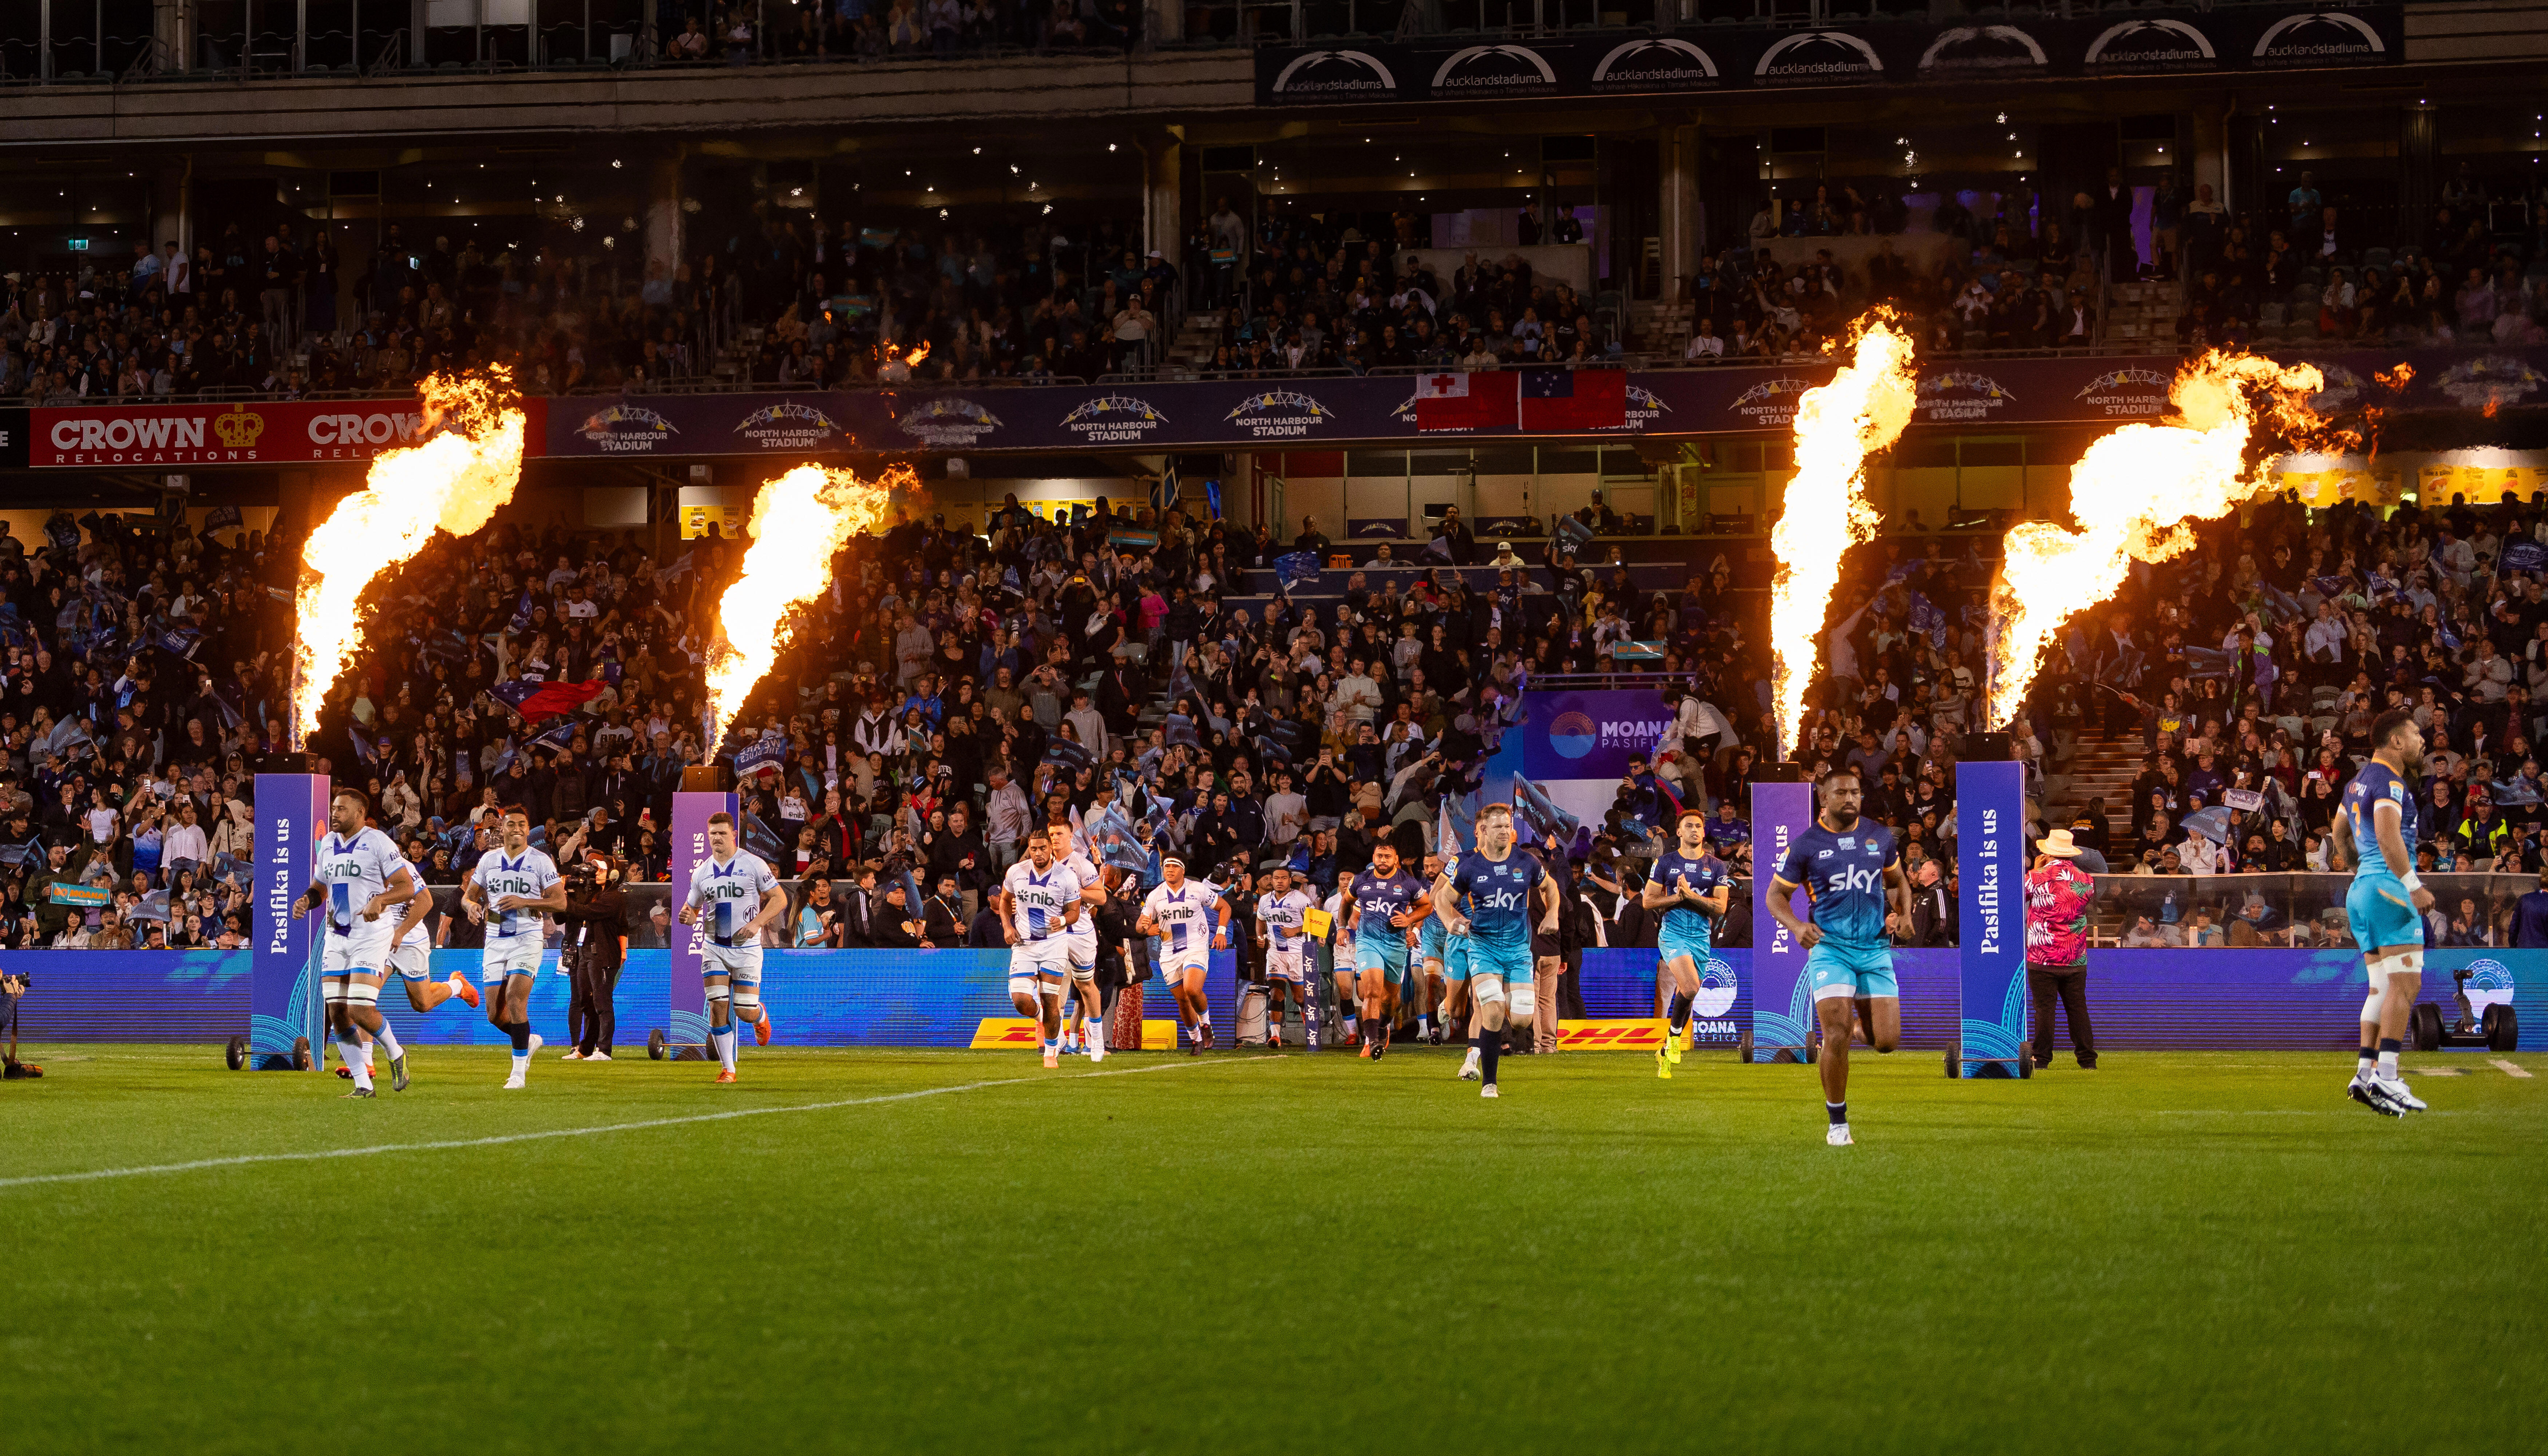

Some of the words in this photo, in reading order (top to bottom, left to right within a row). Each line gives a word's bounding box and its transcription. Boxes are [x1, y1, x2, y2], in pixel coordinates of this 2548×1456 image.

[2268, 43, 2369, 56] aucklandstadiums
[1446, 74, 1541, 86] aucklandstadiums
[1607, 68, 1704, 81] aucklandstadiums
[1625, 410, 1659, 418] RBOUR
[1741, 406, 1775, 415] NORTH
[1071, 423, 1106, 431] NORTH
[1109, 421, 1157, 430] HARBOUR
[1236, 418, 1271, 426] NORTH
[1273, 416, 1322, 425] HARBOUR
[51, 418, 206, 450] CROWN
[620, 432, 668, 440] HARBOUR
[745, 430, 779, 438] NORTH
[1088, 430, 1141, 441] STADIUM
[1253, 426, 1306, 436] STADIUM
[600, 441, 652, 451] STADIUM
[761, 438, 815, 448] STADIUM
[56, 450, 257, 464] RELOCATIONS
[1602, 738, 1660, 748] PASIFI
[1983, 808, 1997, 834] us
[278, 819, 289, 842] us
[1776, 825, 1788, 847] us
[531, 839, 546, 847] OANA
[693, 833, 704, 854] us
[757, 831, 776, 847] MOANA
[272, 848, 289, 864] is
[746, 843, 769, 856] OHNSTON
[1979, 840, 1997, 858] is
[335, 860, 361, 877] nib
[503, 877, 531, 894] nib
[1829, 864, 1881, 894] sky
[54, 887, 68, 897] GO
[717, 882, 744, 898] nib
[1031, 891, 1055, 906] nib
[1482, 887, 1523, 911] sky
[271, 870, 288, 954] Pasifika
[1173, 907, 1194, 919] nib
[1366, 897, 1398, 916] sky
[1978, 864, 1999, 955] Pasifika
[1273, 911, 1293, 923] nib
[355, 961, 379, 969] NZFunds
[516, 962, 535, 972] NZFunds
[1304, 955, 1314, 973] sky
[1304, 980, 1314, 997] sky
[1305, 1004, 1315, 1021] sky
[1309, 1028, 1318, 1046] sky
